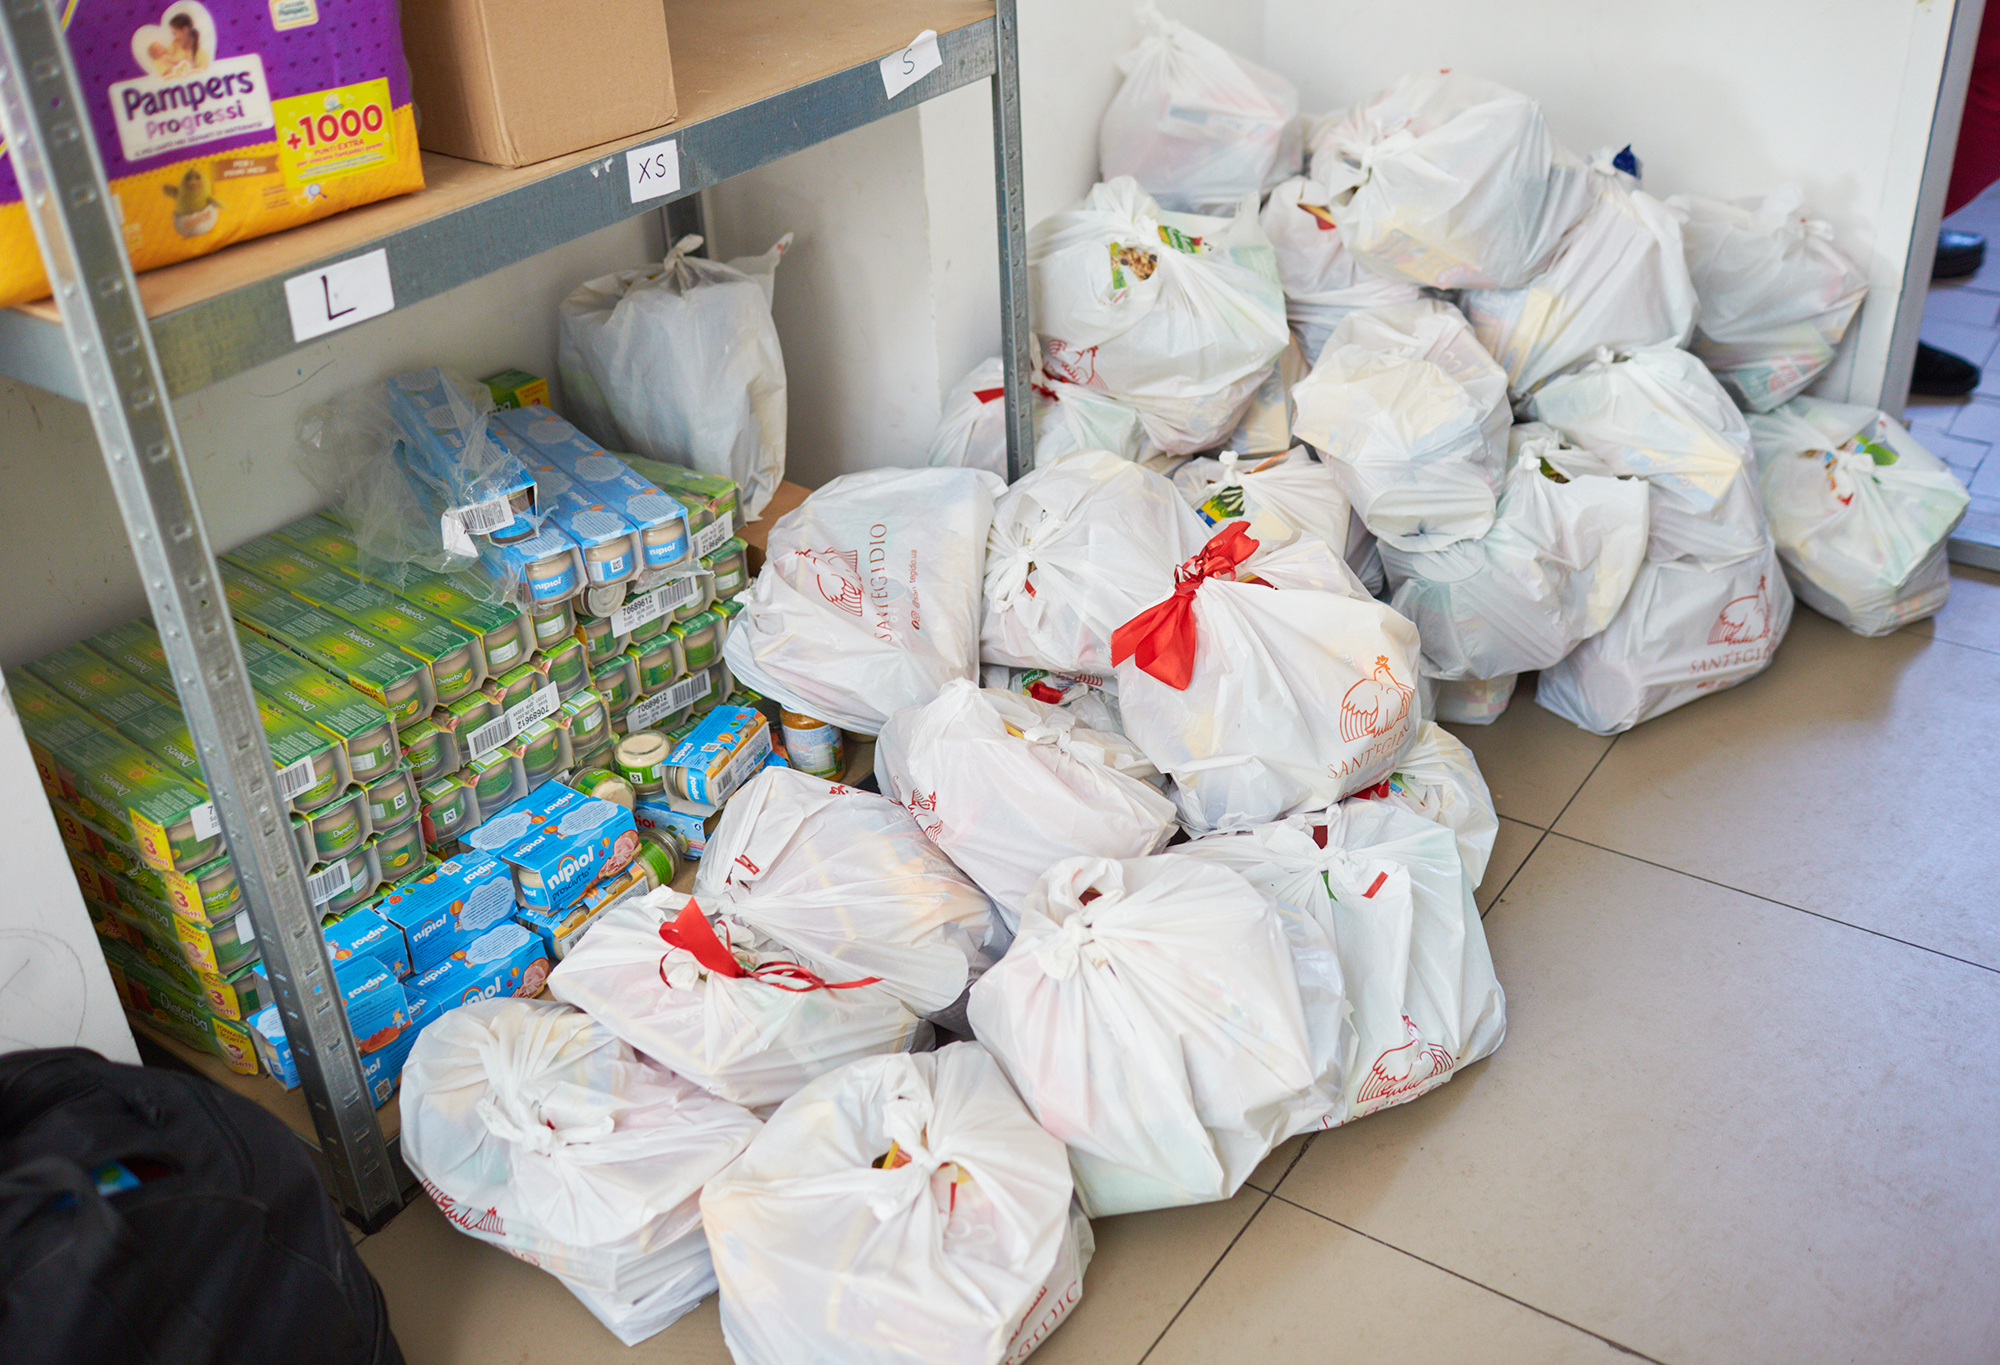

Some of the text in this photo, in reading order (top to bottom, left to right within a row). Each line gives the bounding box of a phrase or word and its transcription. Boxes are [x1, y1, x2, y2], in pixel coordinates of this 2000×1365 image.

[902, 48, 915, 76] S
[121, 71, 254, 121] Pampers
[144, 99, 246, 140] Progressi
[286, 103, 384, 151] +1000
[337, 138, 366, 150] EXTRA
[638, 153, 667, 184] XS
[321, 274, 357, 321] L
[649, 542, 677, 557] nipiol
[534, 576, 563, 592] nipiol
[394, 601, 428, 622] Dieterba
[342, 628, 376, 649] Dieterba
[436, 671, 464, 686] Dieterba
[283, 690, 317, 712] Dieterba
[517, 704, 550, 730] 70689612
[163, 744, 196, 768] Dieterba
[99, 772, 132, 797] Dieterba
[543, 792, 575, 814] nipiol
[143, 836, 158, 855] 3
[513, 834, 546, 858] nipiol
[463, 860, 498, 885] nipiol
[547, 844, 595, 890] nipiol
[174, 890, 190, 909] 3
[351, 923, 389, 950] nipiol
[412, 913, 447, 943] nipiol
[187, 941, 203, 959] 3
[347, 972, 389, 999] nipiol
[417, 961, 453, 987] nipiol
[210, 989, 226, 1006] 3
[159, 991, 209, 1032] Dieterba
